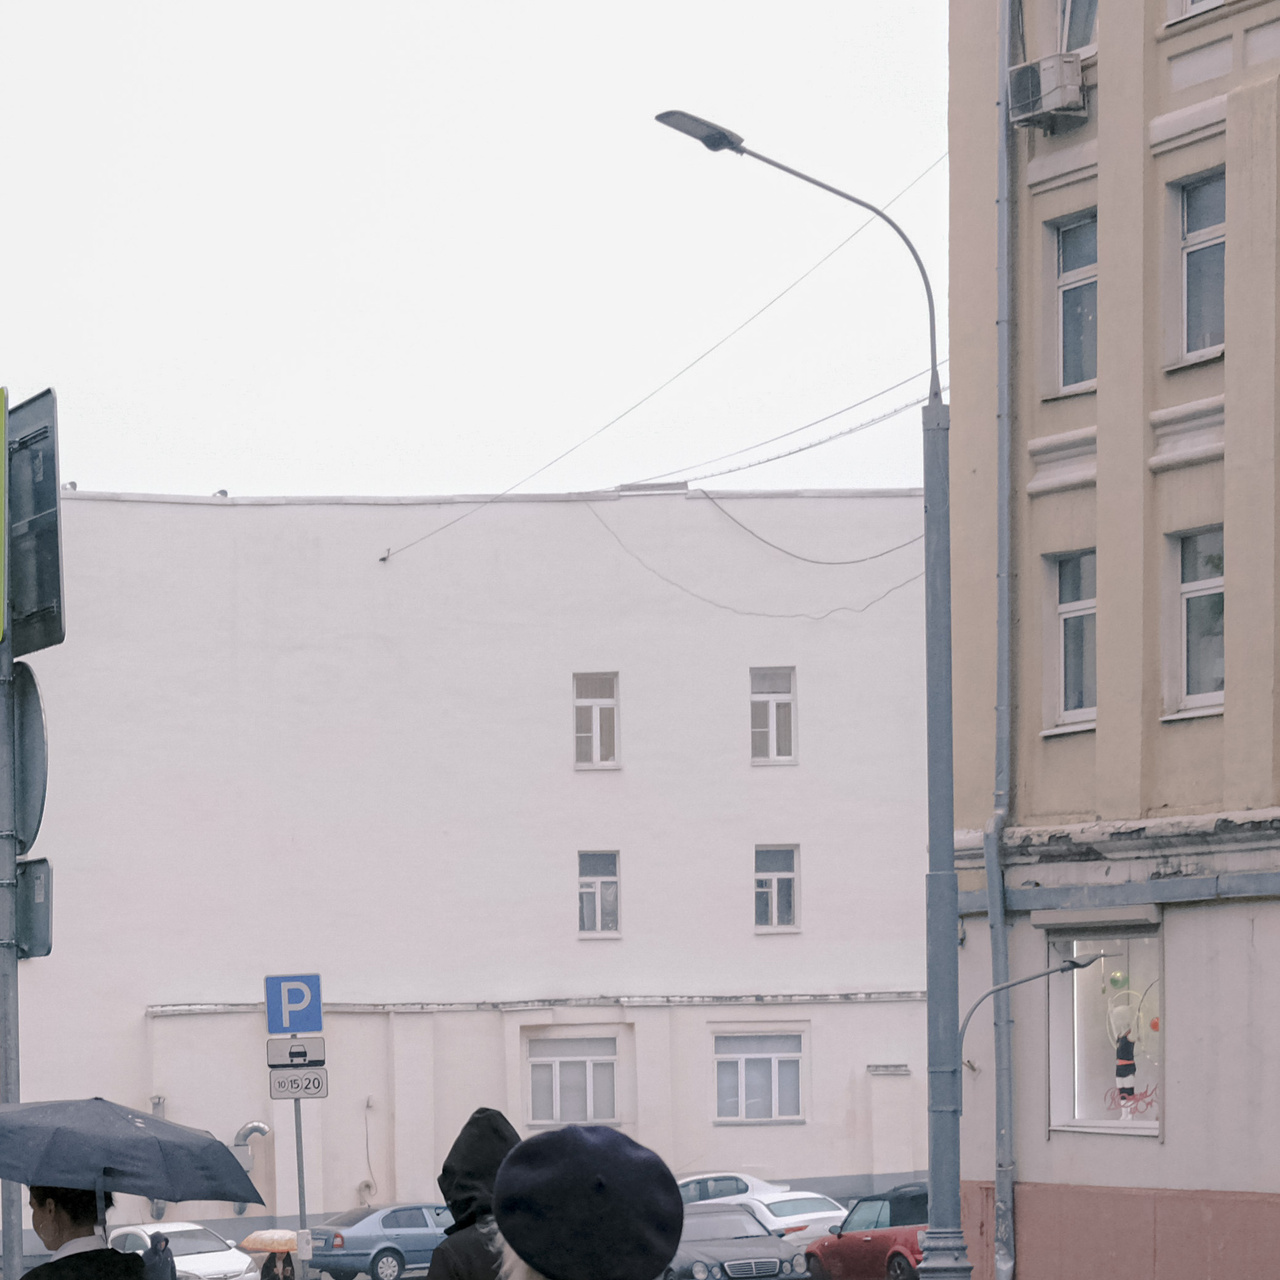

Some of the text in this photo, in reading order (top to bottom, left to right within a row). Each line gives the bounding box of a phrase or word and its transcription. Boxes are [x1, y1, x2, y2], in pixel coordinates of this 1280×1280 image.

[281, 981, 312, 1028] P
[277, 1077, 321, 1090] 10 15 20
